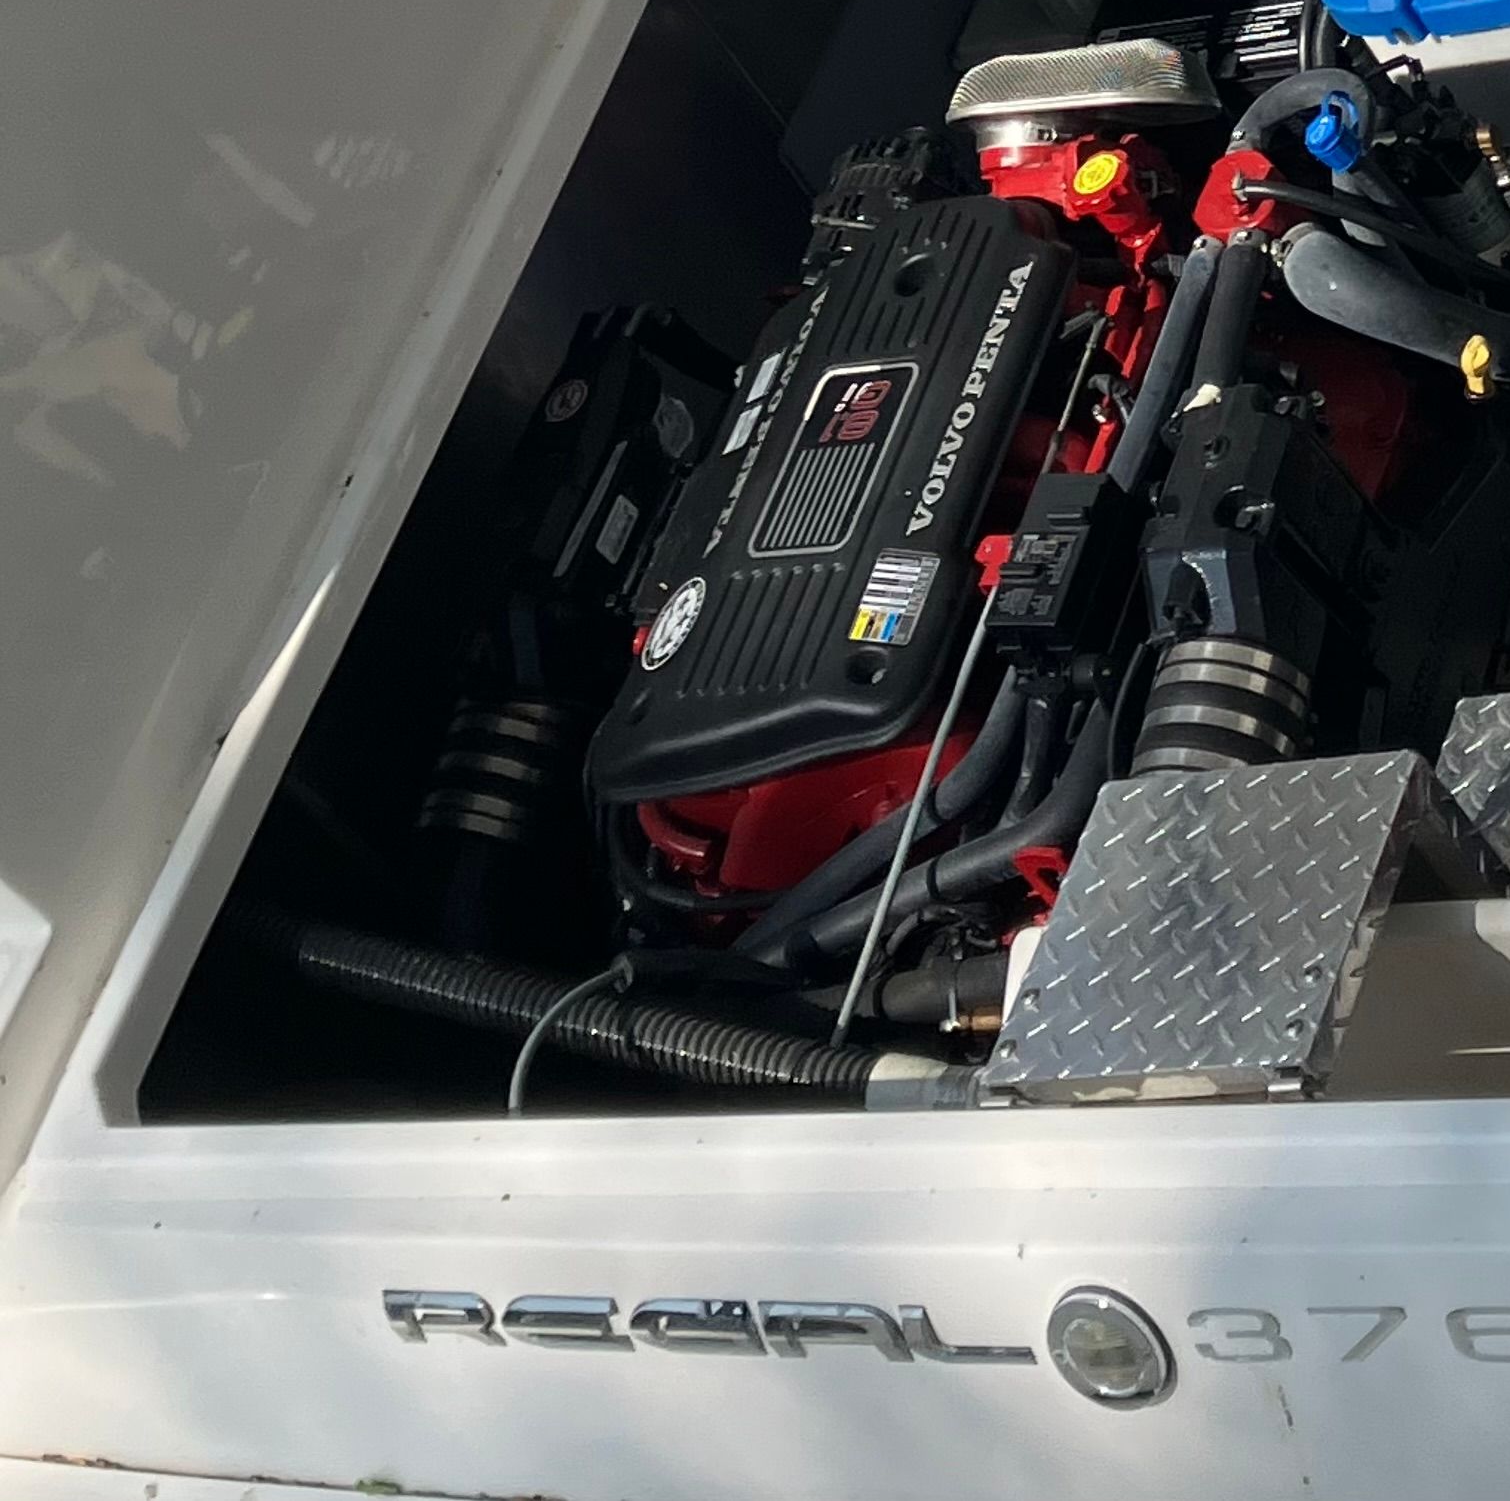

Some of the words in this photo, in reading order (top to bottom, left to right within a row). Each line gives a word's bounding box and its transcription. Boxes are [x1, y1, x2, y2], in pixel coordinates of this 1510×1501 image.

[906, 403, 977, 537] VOLVO
[961, 258, 1036, 399] PENTA
[382, 1289, 1037, 1365] REGAL
